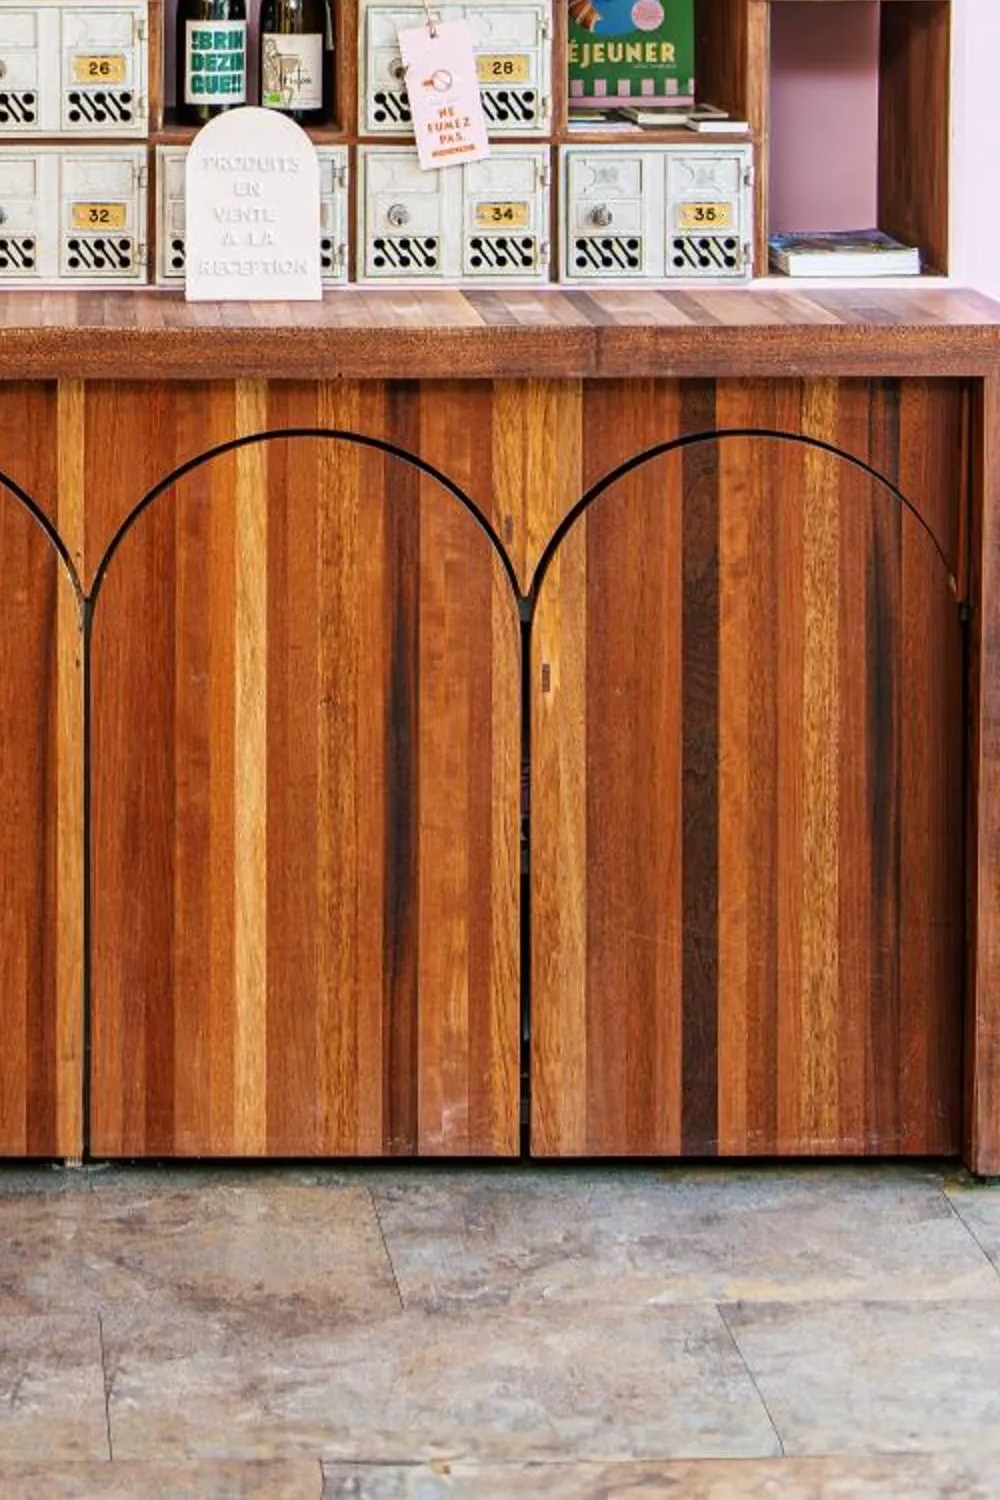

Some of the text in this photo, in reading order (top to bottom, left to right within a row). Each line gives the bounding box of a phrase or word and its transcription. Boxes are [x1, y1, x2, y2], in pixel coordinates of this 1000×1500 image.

[569, 40, 675, 68] ÉJEUNER
[88, 61, 111, 76] 26
[191, 52, 245, 72] DEZIN
[492, 61, 514, 76] 28
[427, 117, 470, 132] FUMEZ
[202, 156, 300, 173] PRODUITS
[233, 182, 262, 197] EN
[89, 208, 110, 223] 32
[212, 207, 277, 223] VENTE
[491, 207, 514, 222] 34
[693, 207, 717, 222] 35
[246, 230, 276, 247] LA
